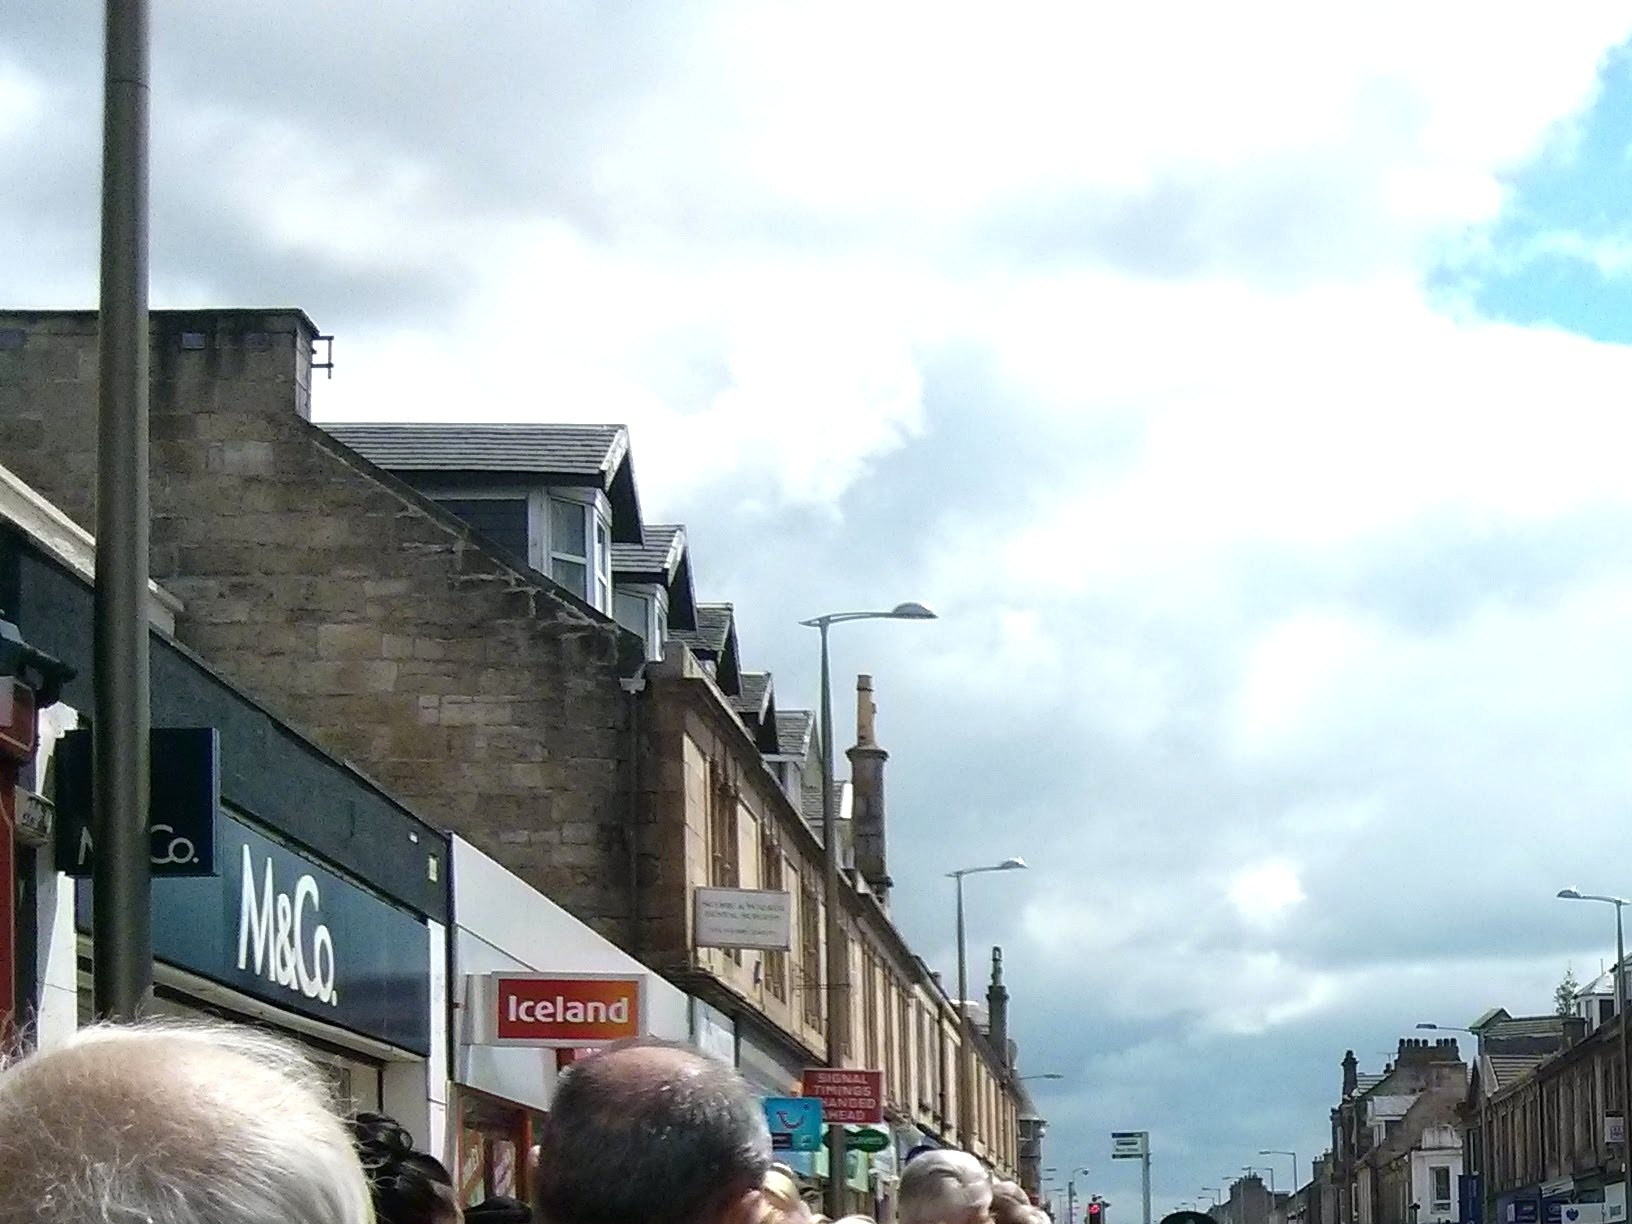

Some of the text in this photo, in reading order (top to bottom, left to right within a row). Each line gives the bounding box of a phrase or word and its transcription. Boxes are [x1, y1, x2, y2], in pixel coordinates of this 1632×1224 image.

[238, 843, 338, 1007] M&Co.
[508, 994, 629, 1025] Iceland
[817, 1072, 868, 1084] SIGNAL
[814, 1084, 872, 1097] TIMINGS
